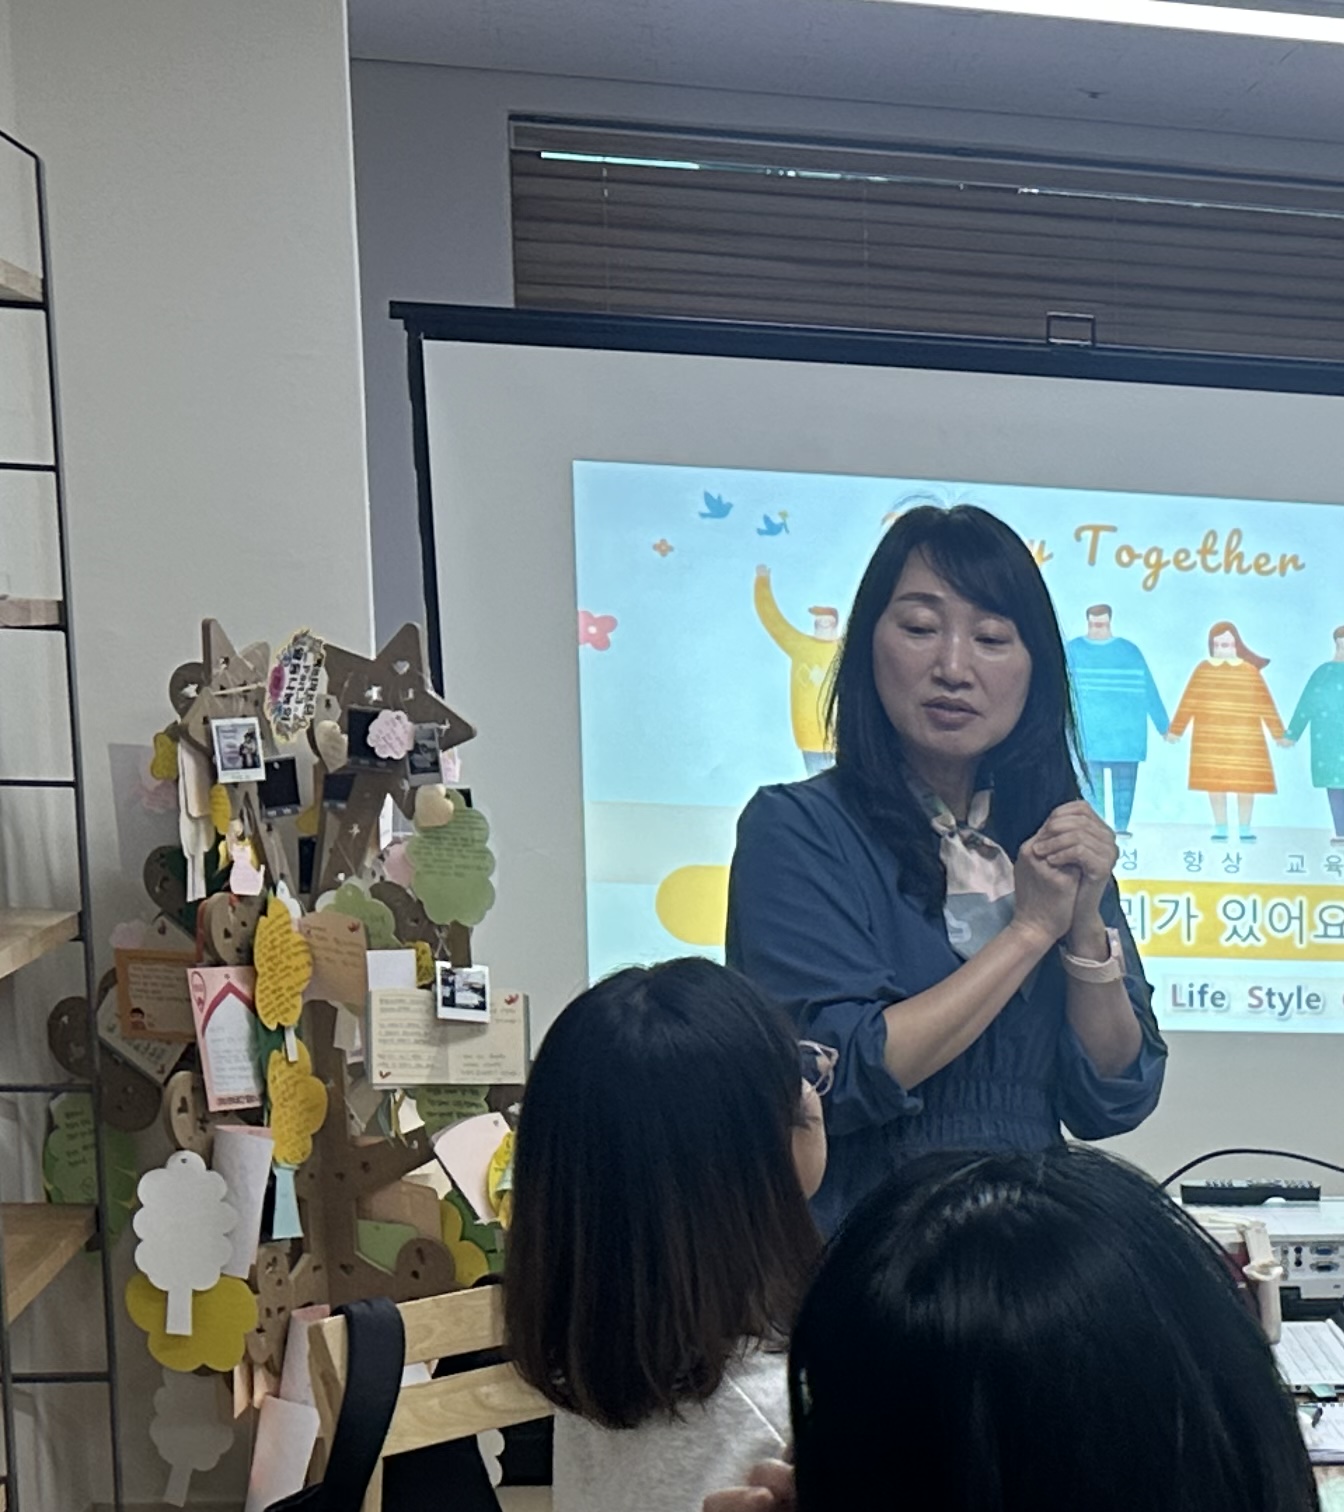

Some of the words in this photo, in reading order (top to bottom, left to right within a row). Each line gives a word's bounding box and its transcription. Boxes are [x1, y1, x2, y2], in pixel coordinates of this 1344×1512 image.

[1074, 523, 1306, 592] Together
[1171, 983, 1227, 1010] Life
[1247, 984, 1322, 1017] Style
